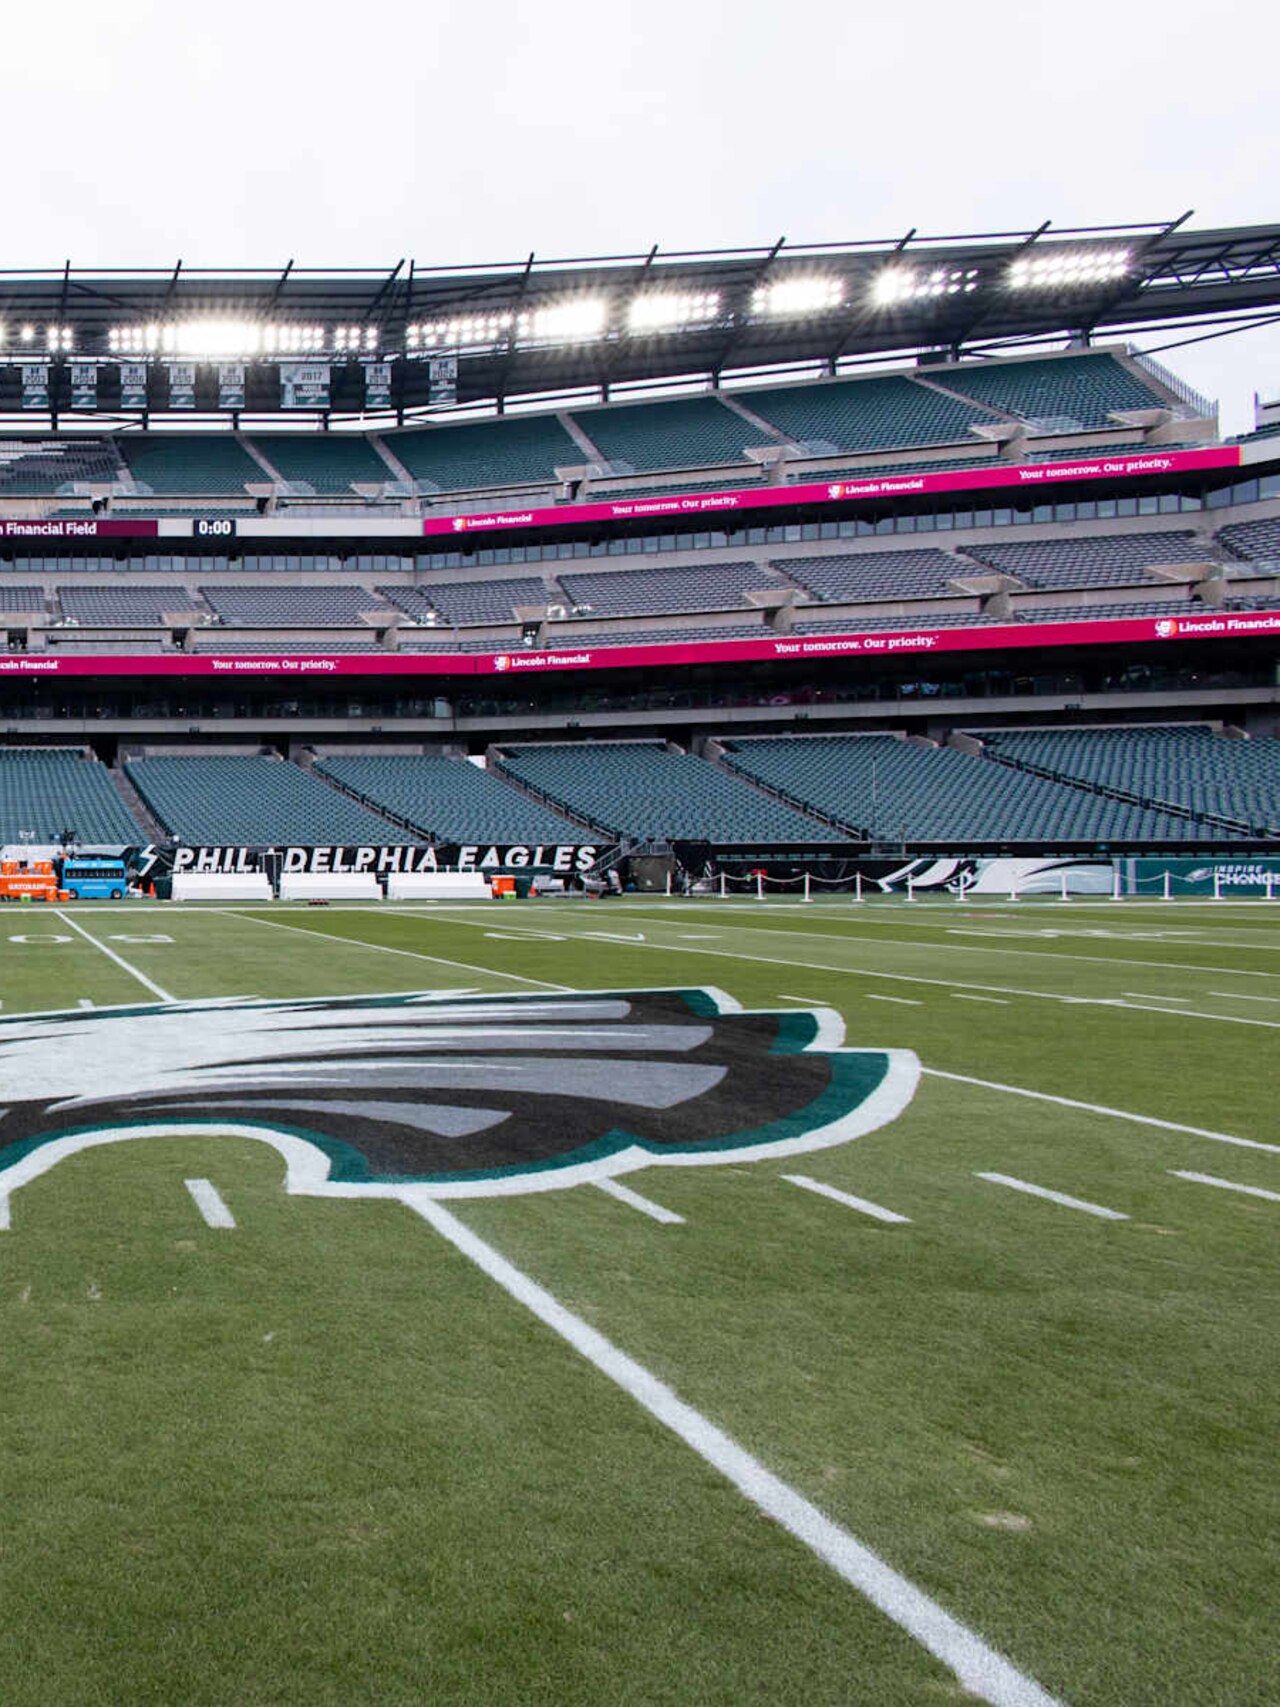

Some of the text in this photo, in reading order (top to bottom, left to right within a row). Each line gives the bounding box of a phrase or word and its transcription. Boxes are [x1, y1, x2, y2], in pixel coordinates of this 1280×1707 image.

[1019, 457, 1171, 479] Your tomorrow. Our priority.
[845, 479, 923, 494] Lincoln Financial
[682, 499, 700, 508] Our
[198, 520, 231, 535] 0:00
[467, 514, 532, 527] Lincoln Financial
[6, 521, 64, 536] Financial
[66, 521, 97, 535] Field
[1178, 620, 1225, 632] Lincoln
[775, 635, 935, 653] Your tomorrow. Our priority.
[20, 660, 58, 670] Financial
[213, 659, 336, 671] Your tomorrow. Our priority.
[512, 653, 590, 667] Lincoln Financial
[173, 846, 597, 872] PHILDELPHIA EAGLES
